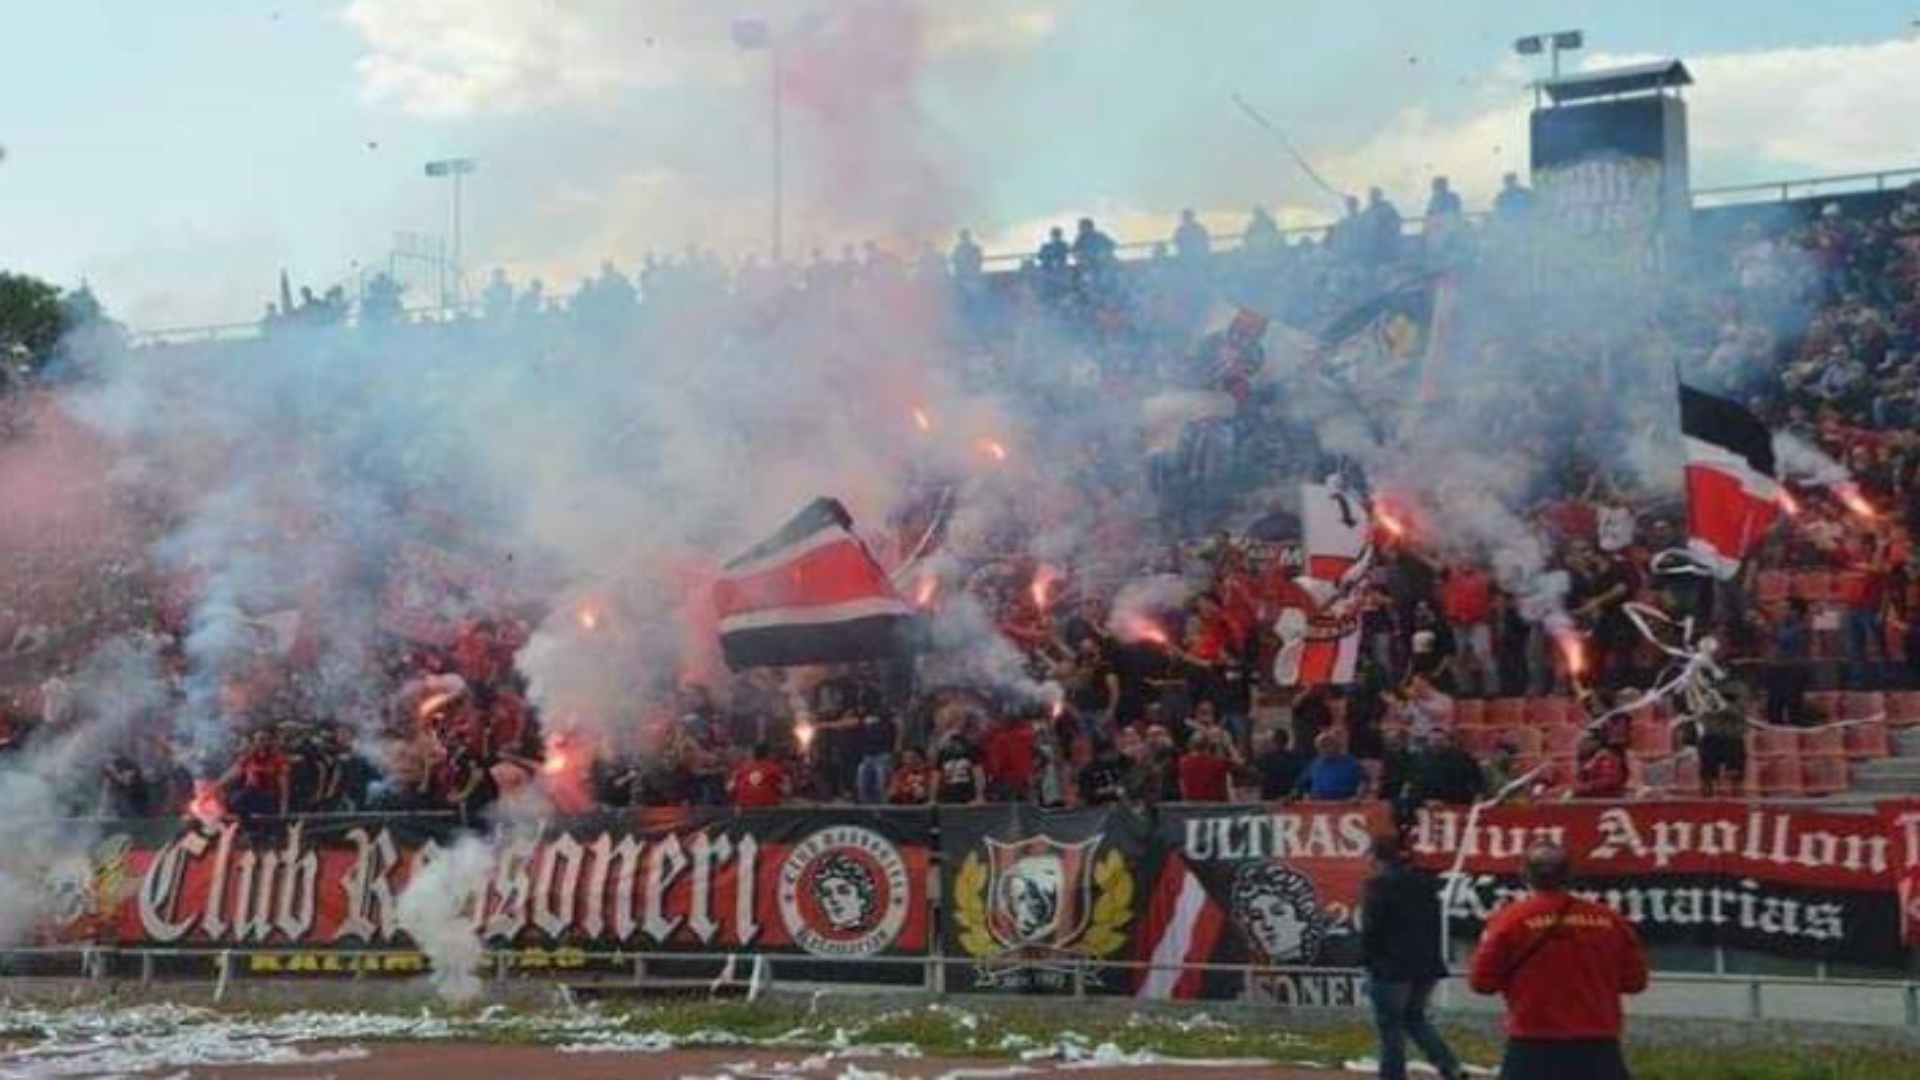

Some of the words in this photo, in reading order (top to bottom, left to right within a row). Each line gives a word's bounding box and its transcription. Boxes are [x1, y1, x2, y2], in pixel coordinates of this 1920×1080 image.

[1185, 811, 1371, 861] ULTRAS
[1588, 808, 1888, 874] Apollon
[140, 819, 317, 941] Club
